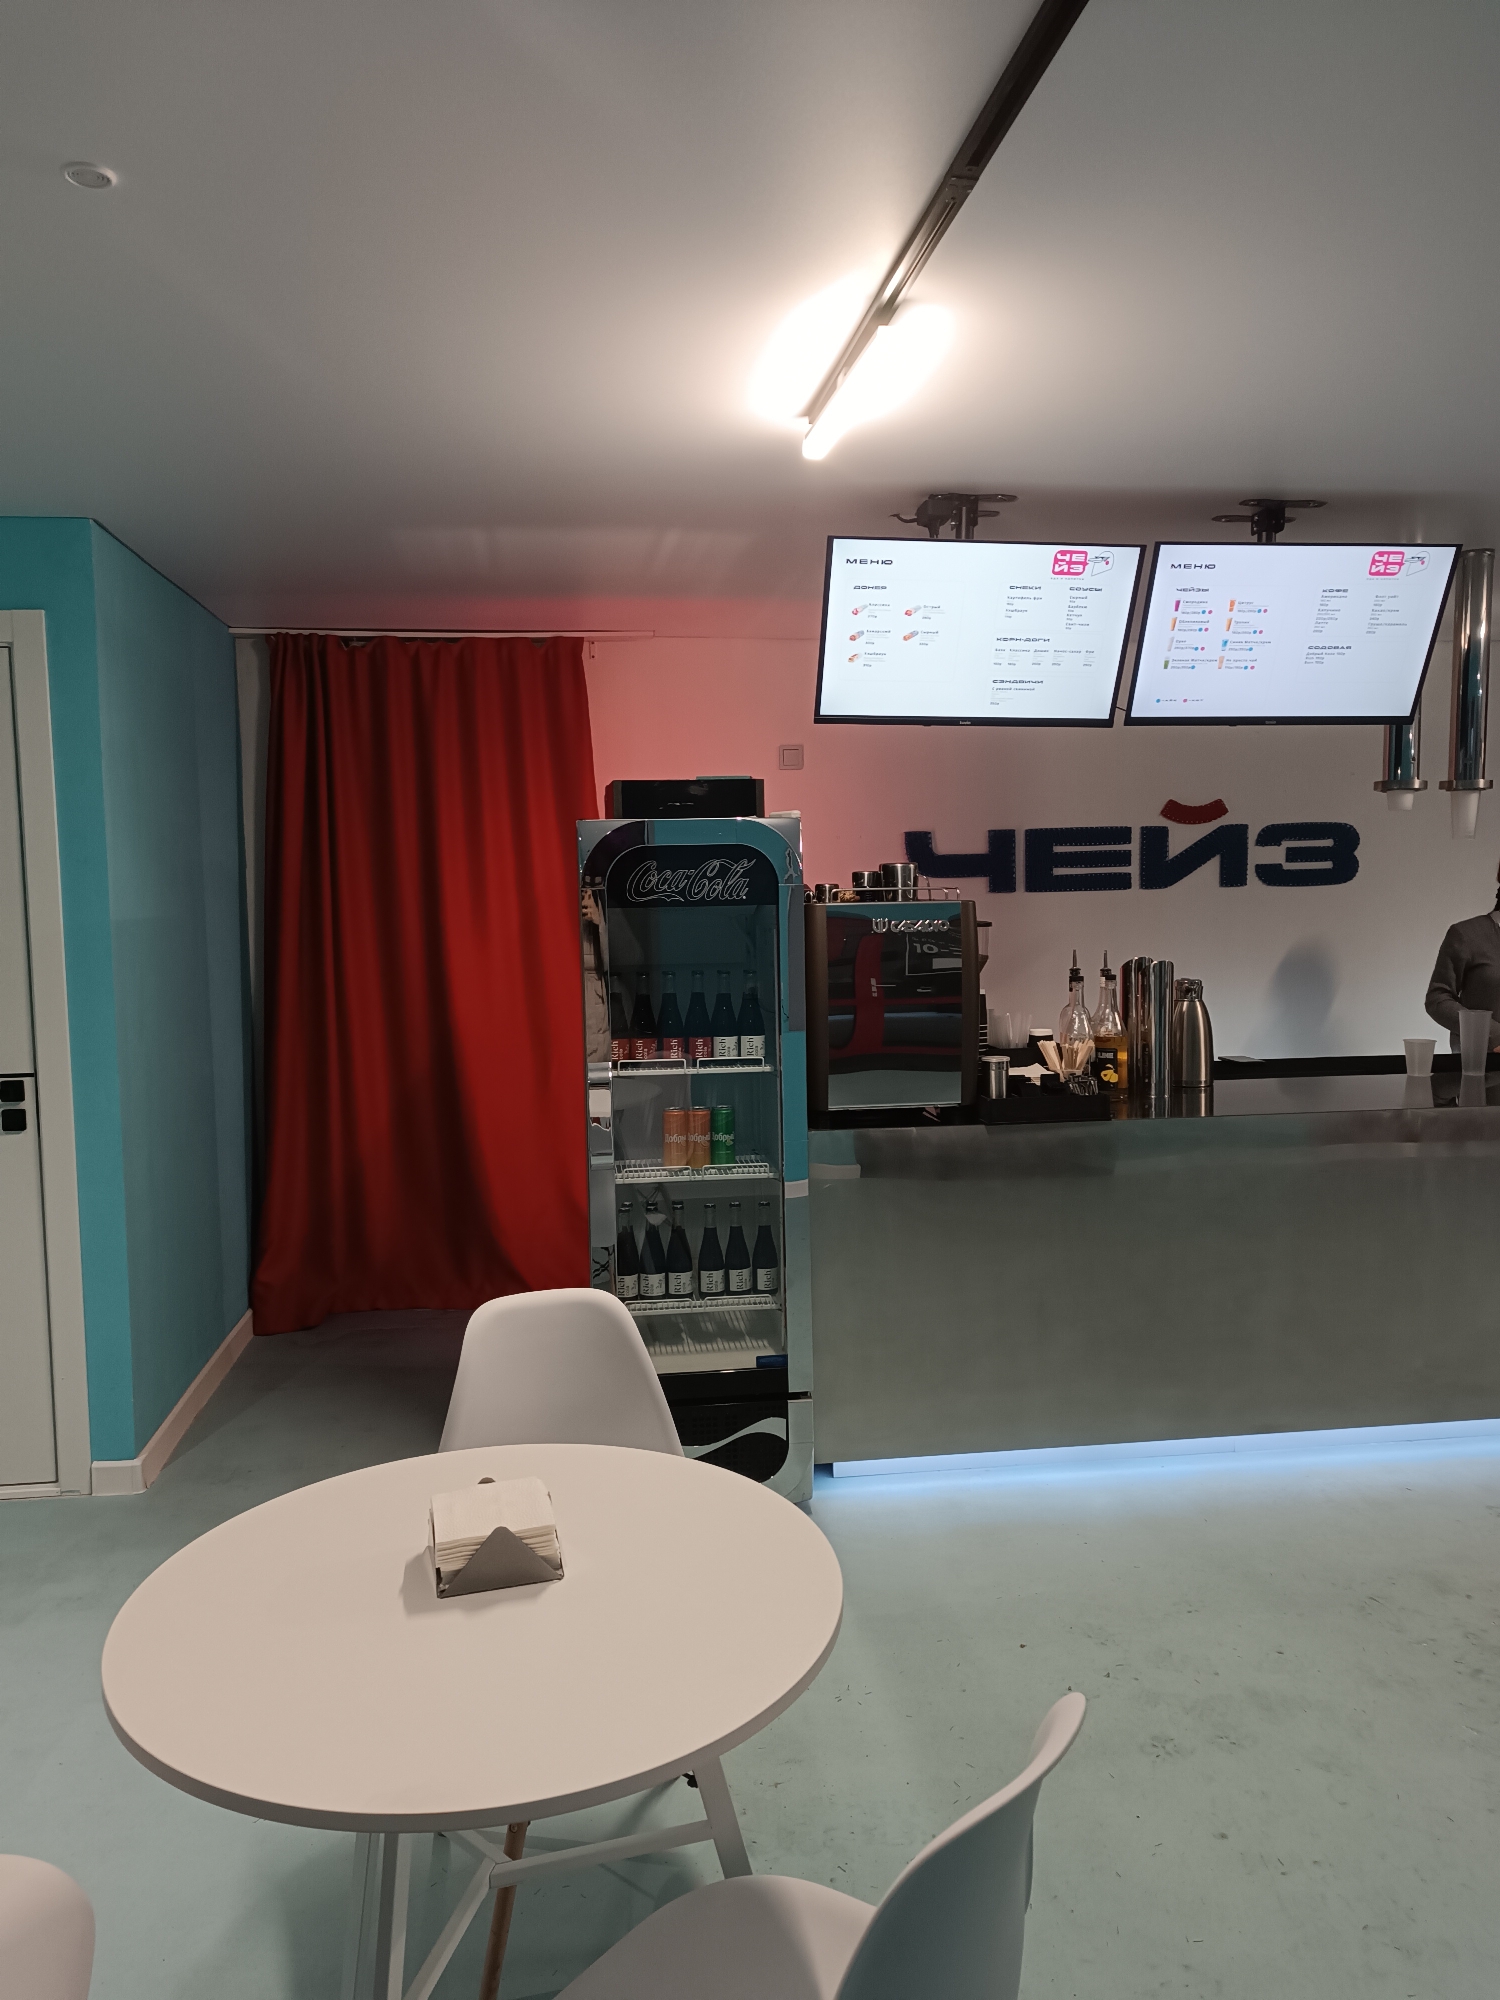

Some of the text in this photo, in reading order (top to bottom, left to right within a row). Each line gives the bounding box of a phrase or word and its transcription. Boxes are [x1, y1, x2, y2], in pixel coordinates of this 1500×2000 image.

[1056, 553, 1086, 562] ЧЕ
[1374, 554, 1403, 562] ЧЕ
[1054, 562, 1084, 572] ЙЗ
[1371, 562, 1400, 573] ЙЗ
[904, 799, 1360, 893] ЧЕЙЗ
[626, 858, 756, 902] Coca-Cola
